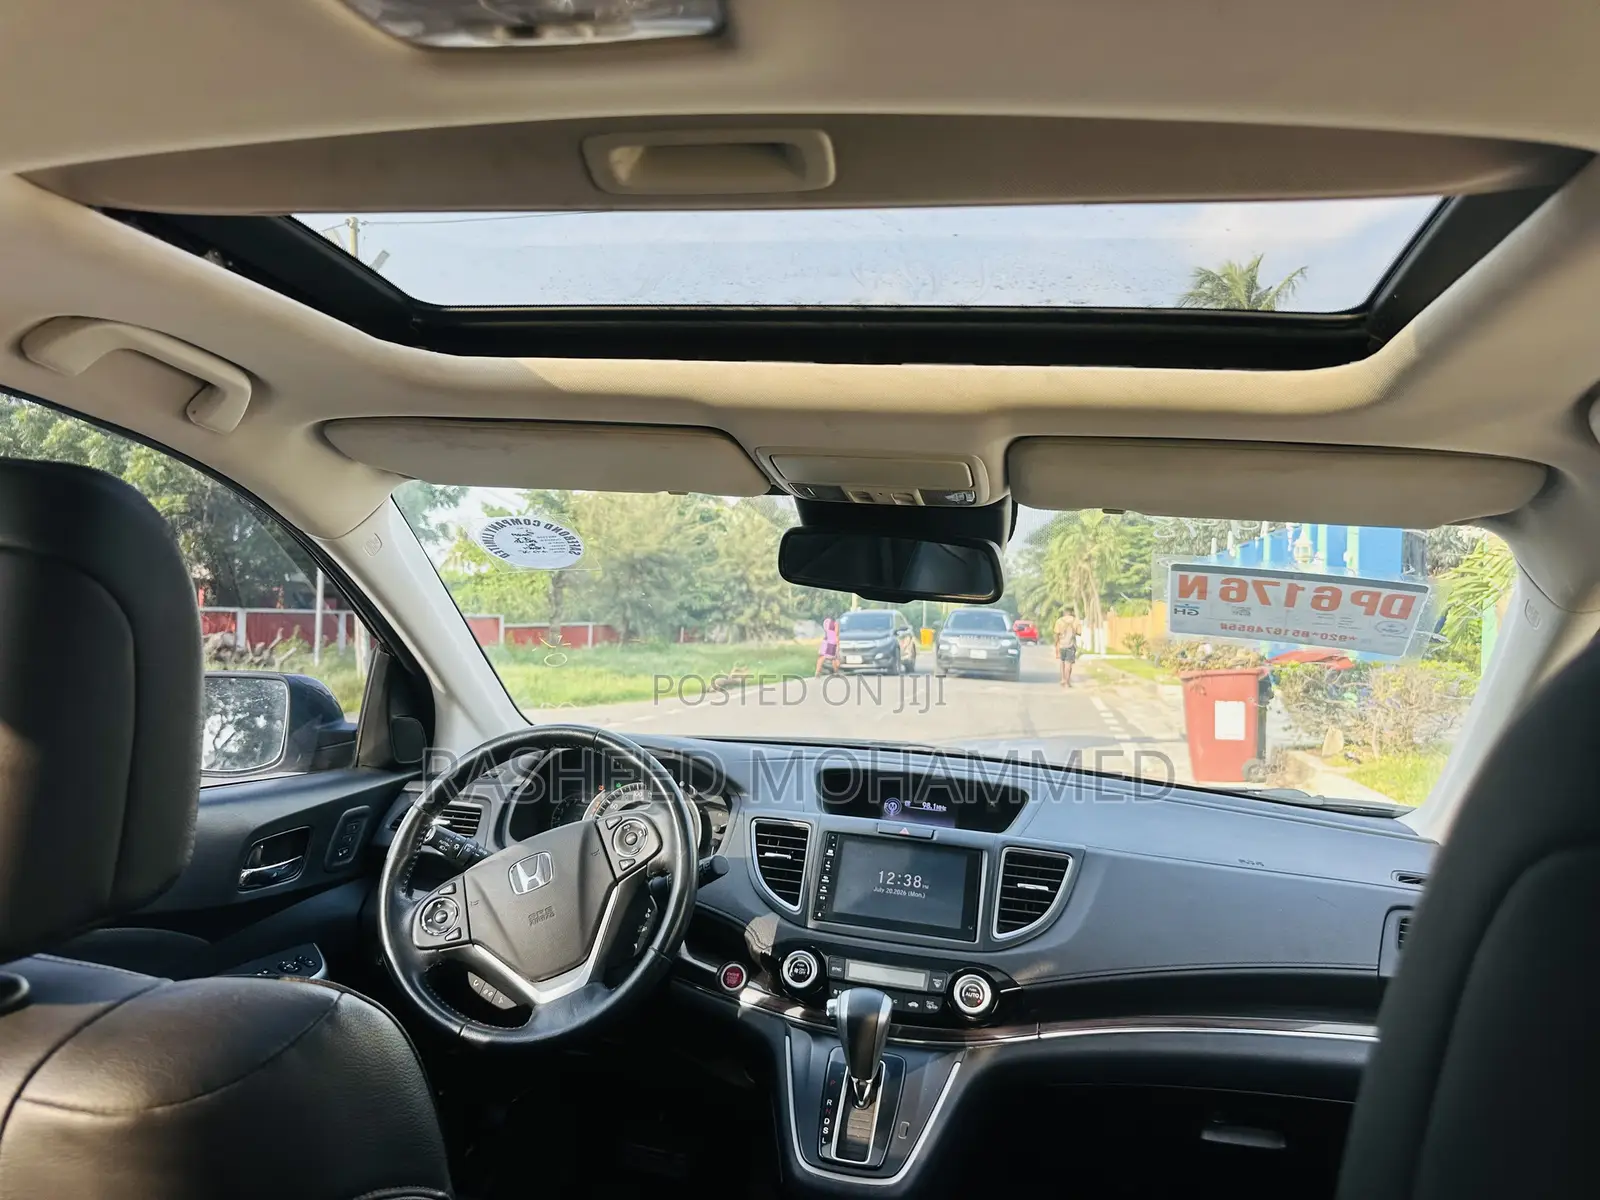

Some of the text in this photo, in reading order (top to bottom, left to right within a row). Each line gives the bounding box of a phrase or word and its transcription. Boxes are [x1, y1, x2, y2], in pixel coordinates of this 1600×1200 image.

[879, 870, 922, 888] 12:38
[826, 1098, 833, 1106] R
[823, 1117, 830, 1125] D
[822, 1126, 829, 1135] S
[821, 1136, 827, 1144] L
